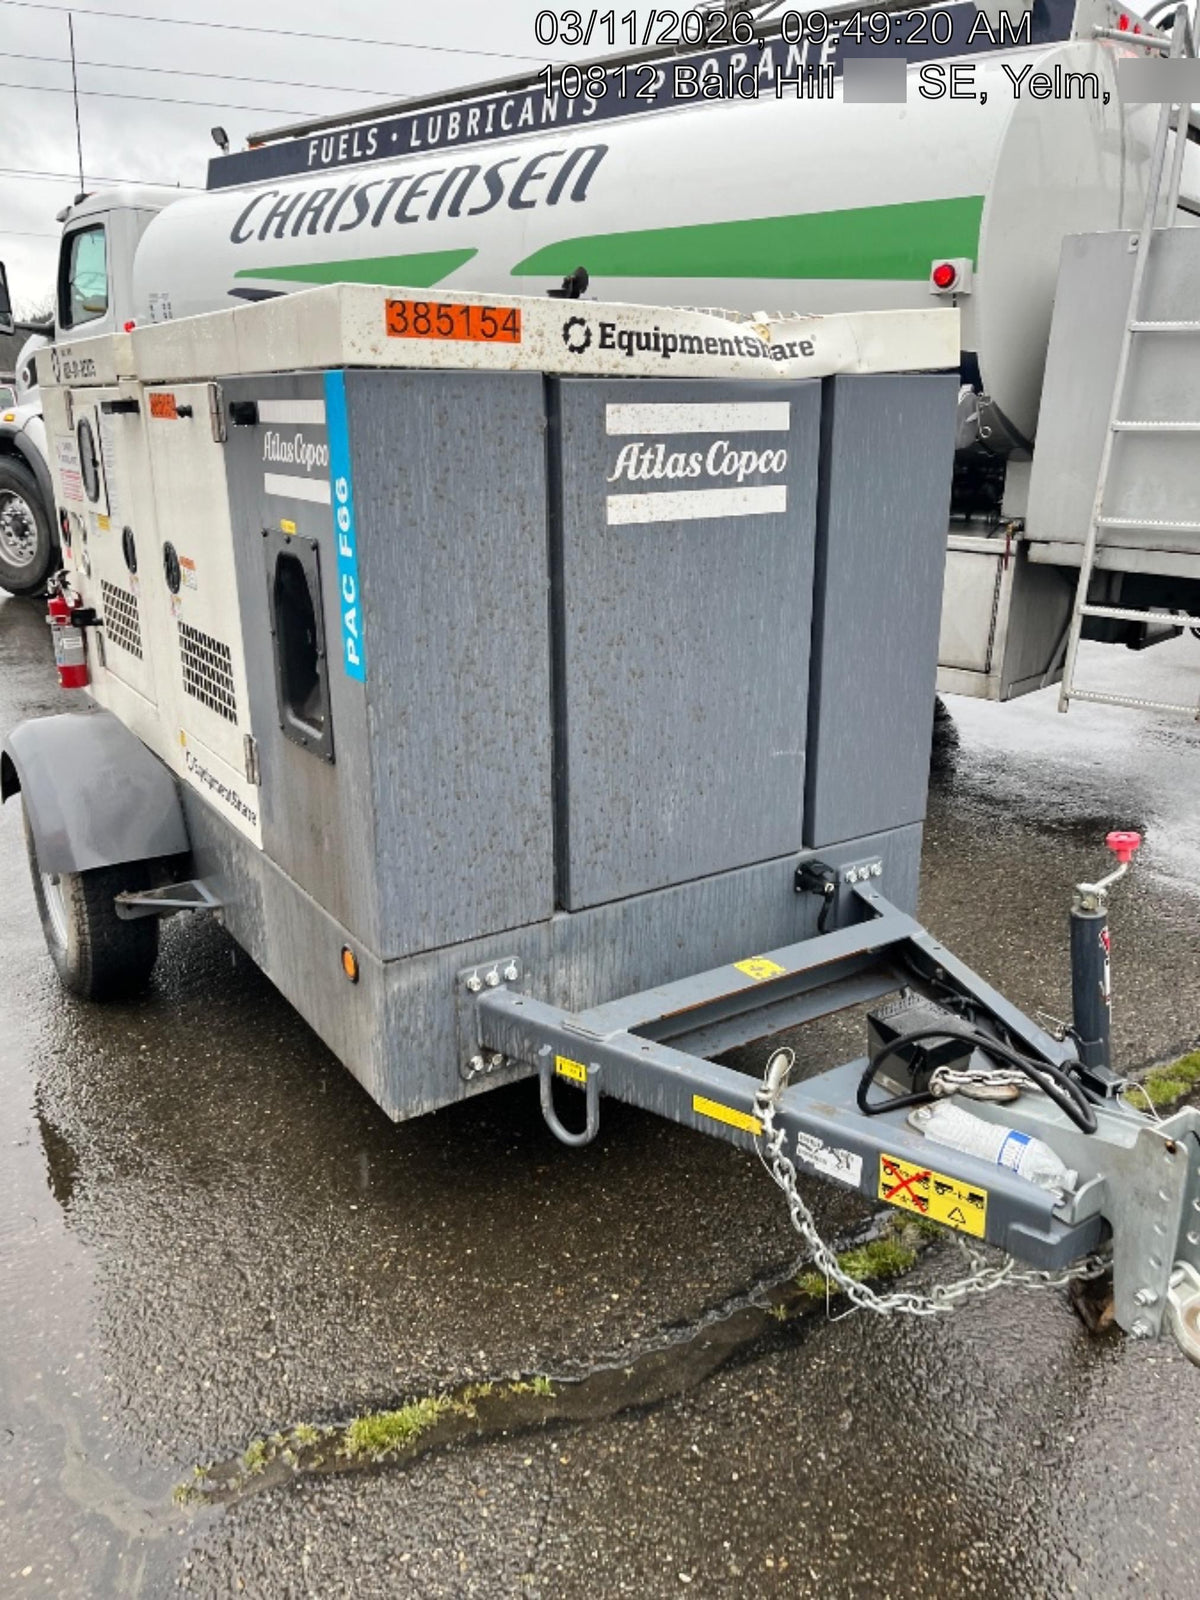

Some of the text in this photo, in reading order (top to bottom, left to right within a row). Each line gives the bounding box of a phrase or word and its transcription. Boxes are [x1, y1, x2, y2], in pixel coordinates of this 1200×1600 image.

[307, 127, 379, 166] FUELS
[410, 83, 598, 147] LUBRICANTS
[229, 143, 609, 244] CHRISTENSEN
[389, 300, 520, 339] 385154
[599, 322, 816, 361] EquipmentShare
[606, 440, 787, 482] Atlas Copco
[335, 476, 361, 666] PAC F66
